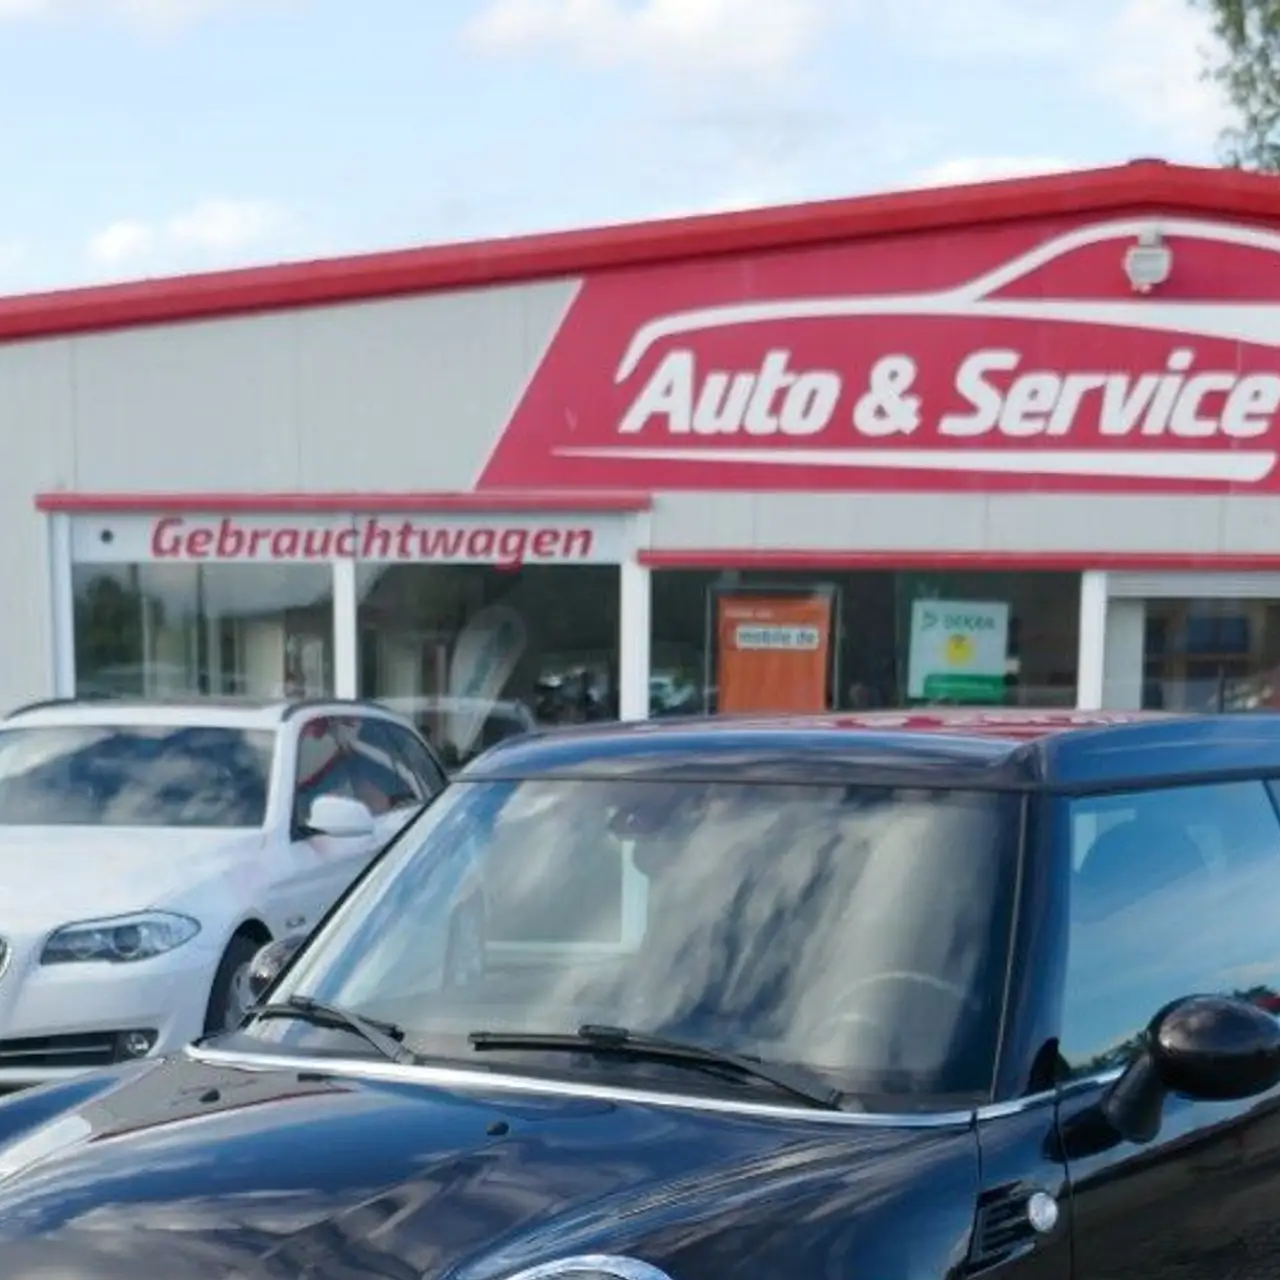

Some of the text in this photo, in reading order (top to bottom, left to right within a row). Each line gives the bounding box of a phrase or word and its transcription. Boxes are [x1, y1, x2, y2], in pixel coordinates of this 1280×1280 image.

[619, 348, 840, 436] Auto
[852, 353, 923, 436] &
[150, 514, 595, 572] Gebrauchtwagen
[737, 630, 816, 647] mobilede
